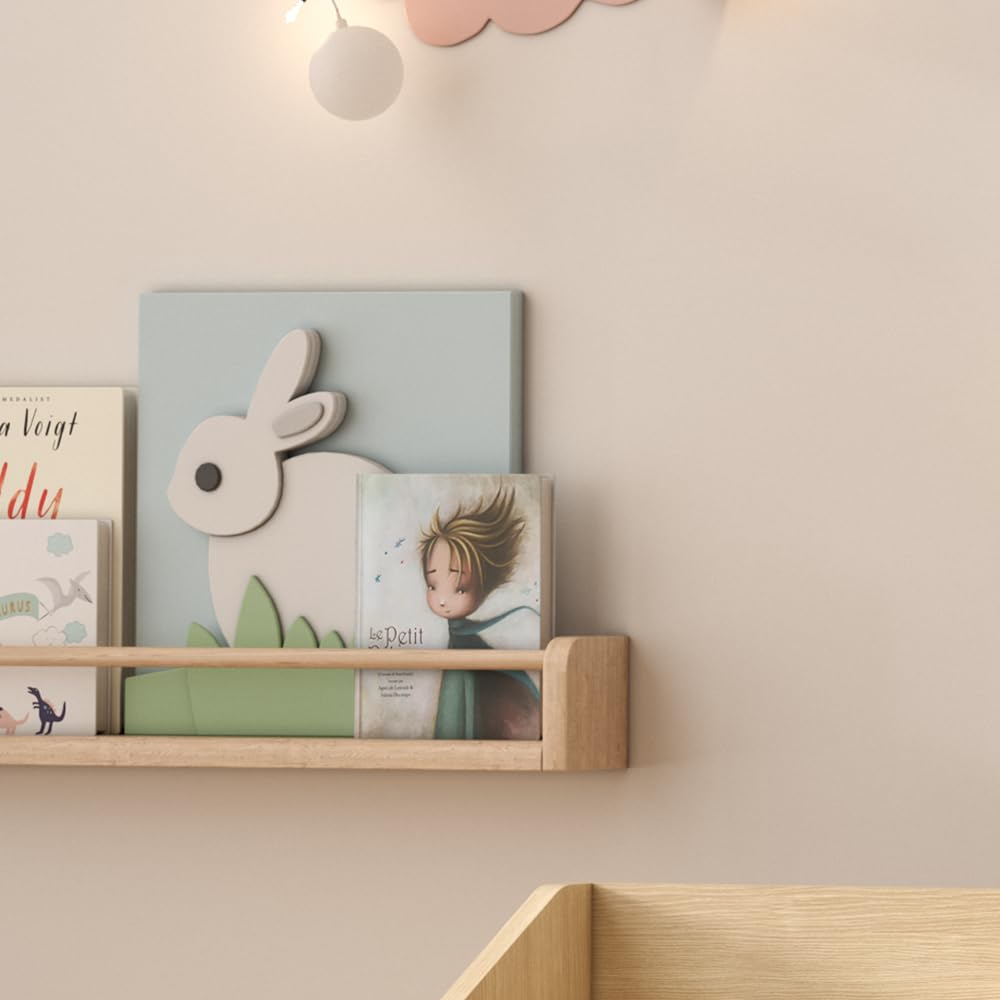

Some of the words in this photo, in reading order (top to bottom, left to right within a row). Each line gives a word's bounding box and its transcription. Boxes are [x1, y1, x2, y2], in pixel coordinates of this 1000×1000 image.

[23, 408, 77, 452] Voigt
[369, 626, 383, 640] Le
[384, 625, 424, 649] Petit
